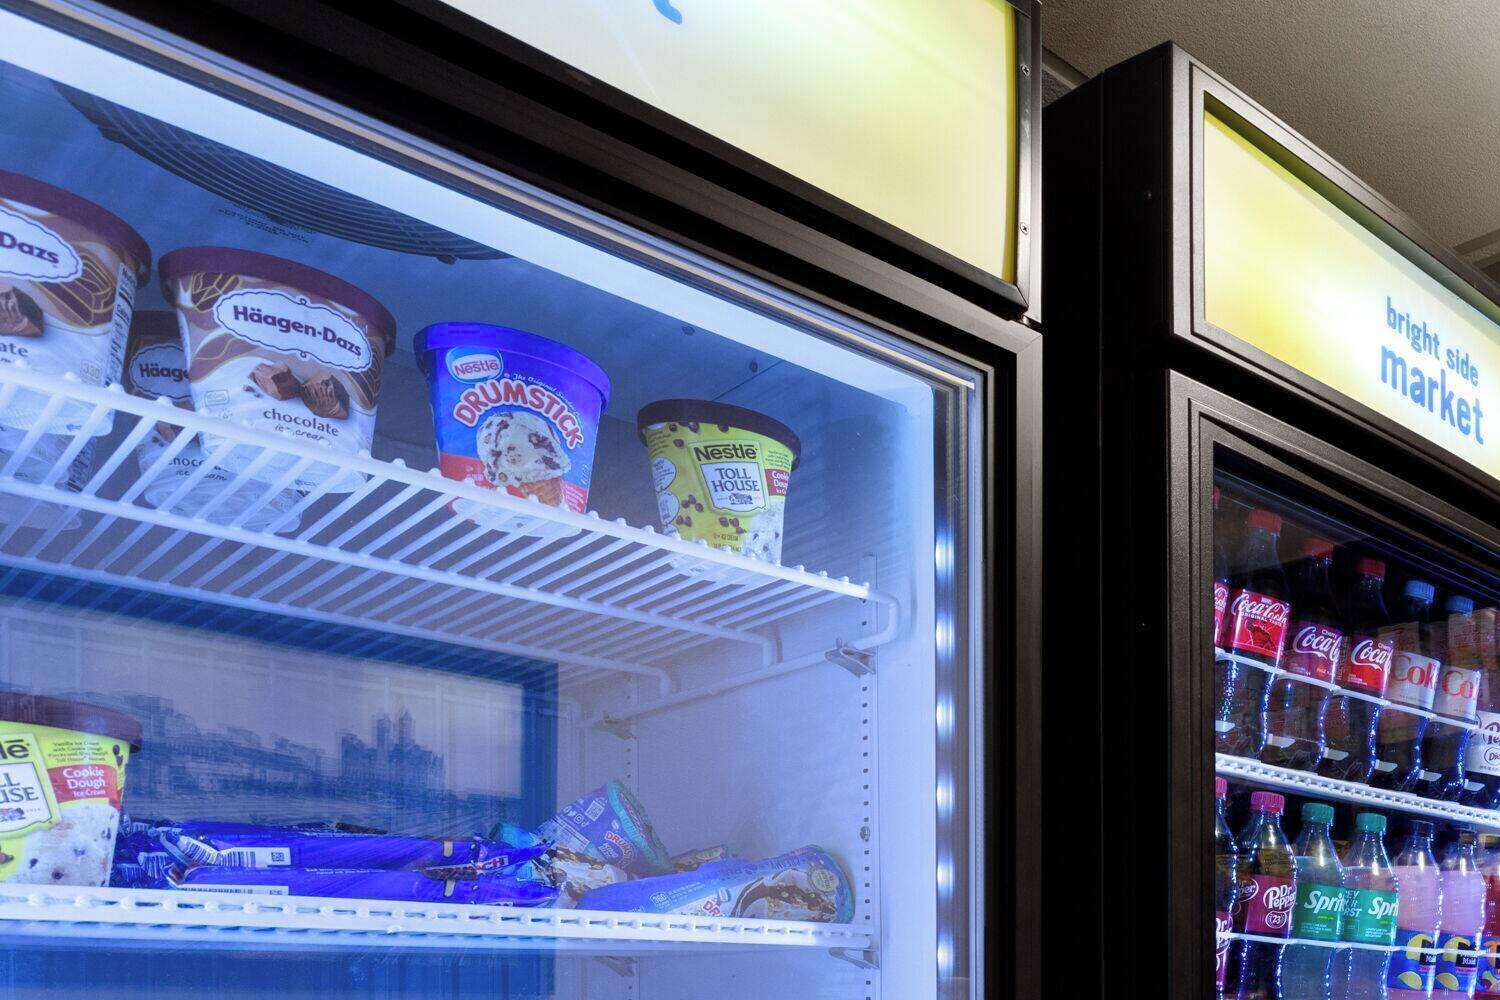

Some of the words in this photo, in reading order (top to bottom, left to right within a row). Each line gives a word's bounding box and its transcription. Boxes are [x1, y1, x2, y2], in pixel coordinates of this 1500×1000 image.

[233, 305, 362, 359] Häagen-Dazs
[1386, 296, 1441, 359] bright
[1447, 348, 1479, 387] side
[1381, 345, 1484, 445] market
[263, 408, 340, 437] chocolate
[454, 378, 583, 449] DRUMSTICK
[715, 468, 751, 480] TOLL
[712, 480, 760, 493] HOUSE
[1231, 594, 1288, 625] Coca-Cola
[1241, 611, 1268, 622] ORIGINAL
[63, 766, 105, 779] Cookie
[67, 778, 105, 789] Dough
[1280, 885, 1293, 898] Dr
